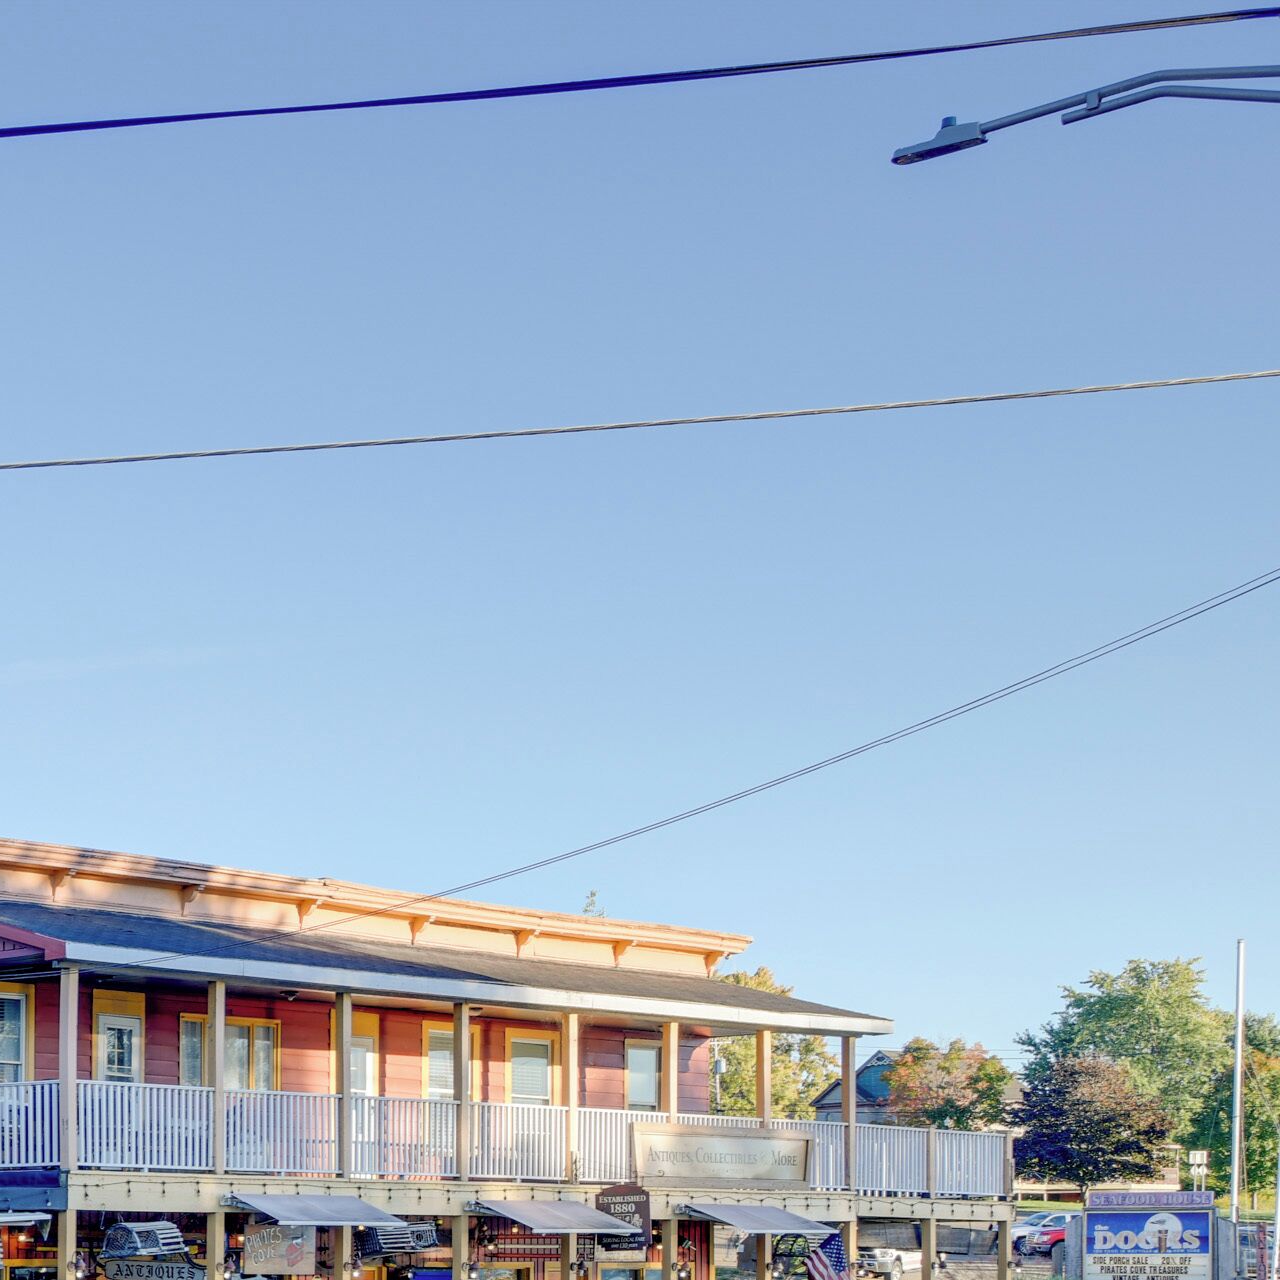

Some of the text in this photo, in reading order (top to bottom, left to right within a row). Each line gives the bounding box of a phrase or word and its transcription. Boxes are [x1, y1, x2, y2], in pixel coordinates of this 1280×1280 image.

[695, 1147, 758, 1165] COLLECTIBLES
[771, 1150, 798, 1166] MORE
[599, 1195, 646, 1203] ESTABLISHED
[1093, 1193, 1210, 1205] SEAFOOD HOUSE
[610, 1203, 635, 1213] 1880
[246, 1227, 281, 1254] PIRATES
[1093, 1230, 1200, 1250] DOCKS
[252, 1245, 276, 1265] COVE
[1110, 1257, 1130, 1265] PORCH
[1132, 1257, 1148, 1265] SALE
[1180, 1257, 1192, 1265] OFF
[1100, 1266, 1188, 1274] PIRATES COVE TREASURES
